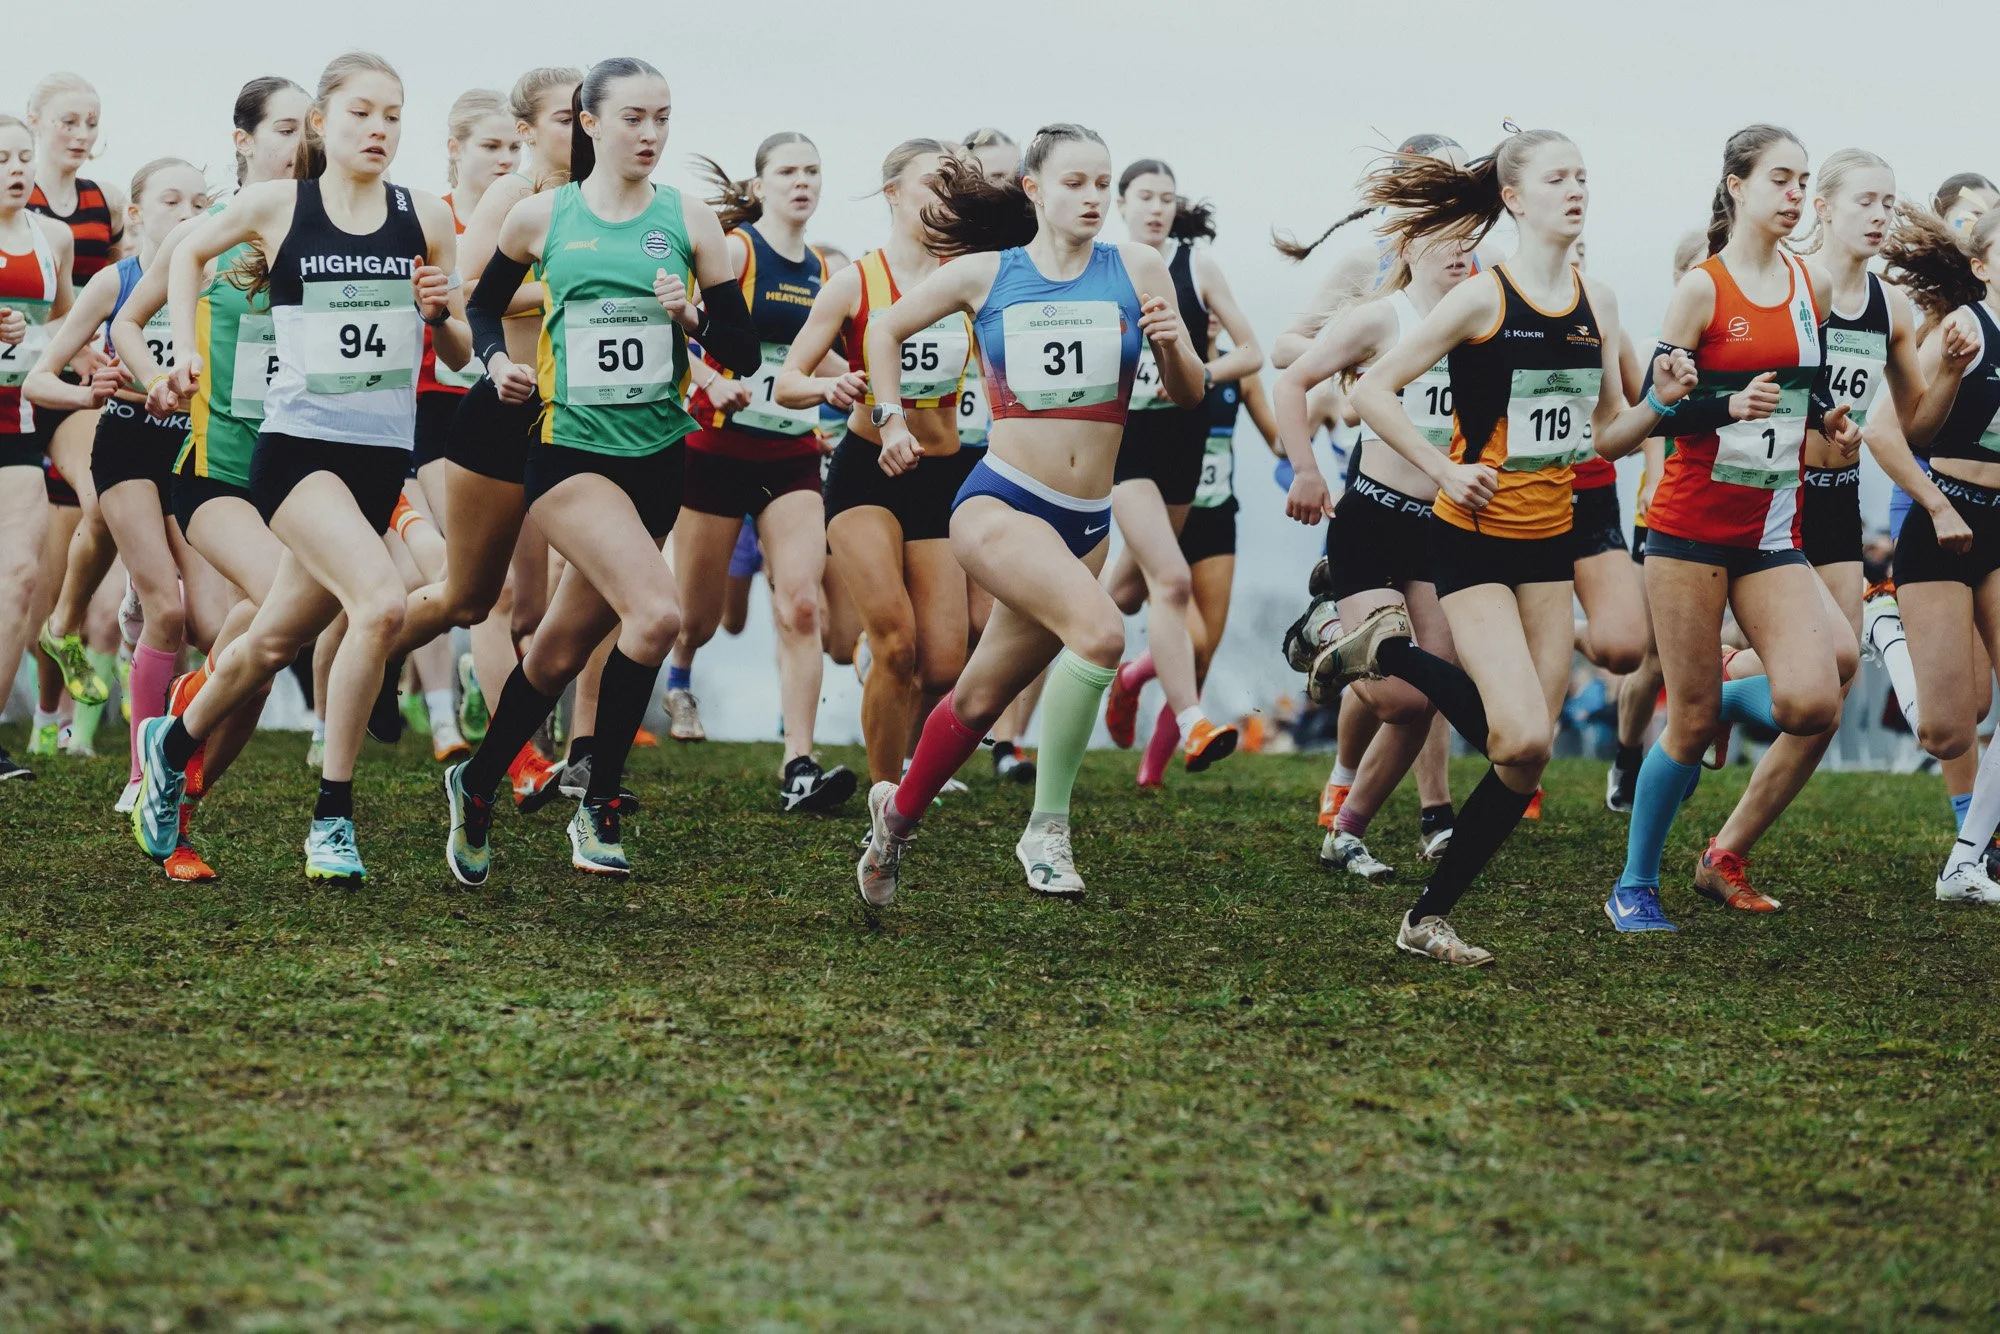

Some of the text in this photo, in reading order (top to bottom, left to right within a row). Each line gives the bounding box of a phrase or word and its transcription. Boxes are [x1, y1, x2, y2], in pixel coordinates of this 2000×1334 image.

[779, 283, 811, 295] LONDON
[329, 300, 391, 309] SEDGEFIELD
[589, 315, 648, 325] SEDGEFIELD
[1029, 318, 1093, 328] SEDGEFIELD
[339, 323, 387, 359] 94
[1513, 329, 1545, 339] KUKRI
[598, 338, 644, 372] 50
[900, 342, 939, 372] 55
[1043, 340, 1084, 376] 31
[1826, 344, 1870, 355] SEDGEFIELD
[1533, 386, 1582, 395] SEDGEFIELD
[1529, 406, 1571, 442] 119
[1761, 428, 1776, 459] 1
[1204, 465, 1216, 485] 3
[1804, 470, 1834, 487] KE
[1353, 475, 1401, 509] NIKE
